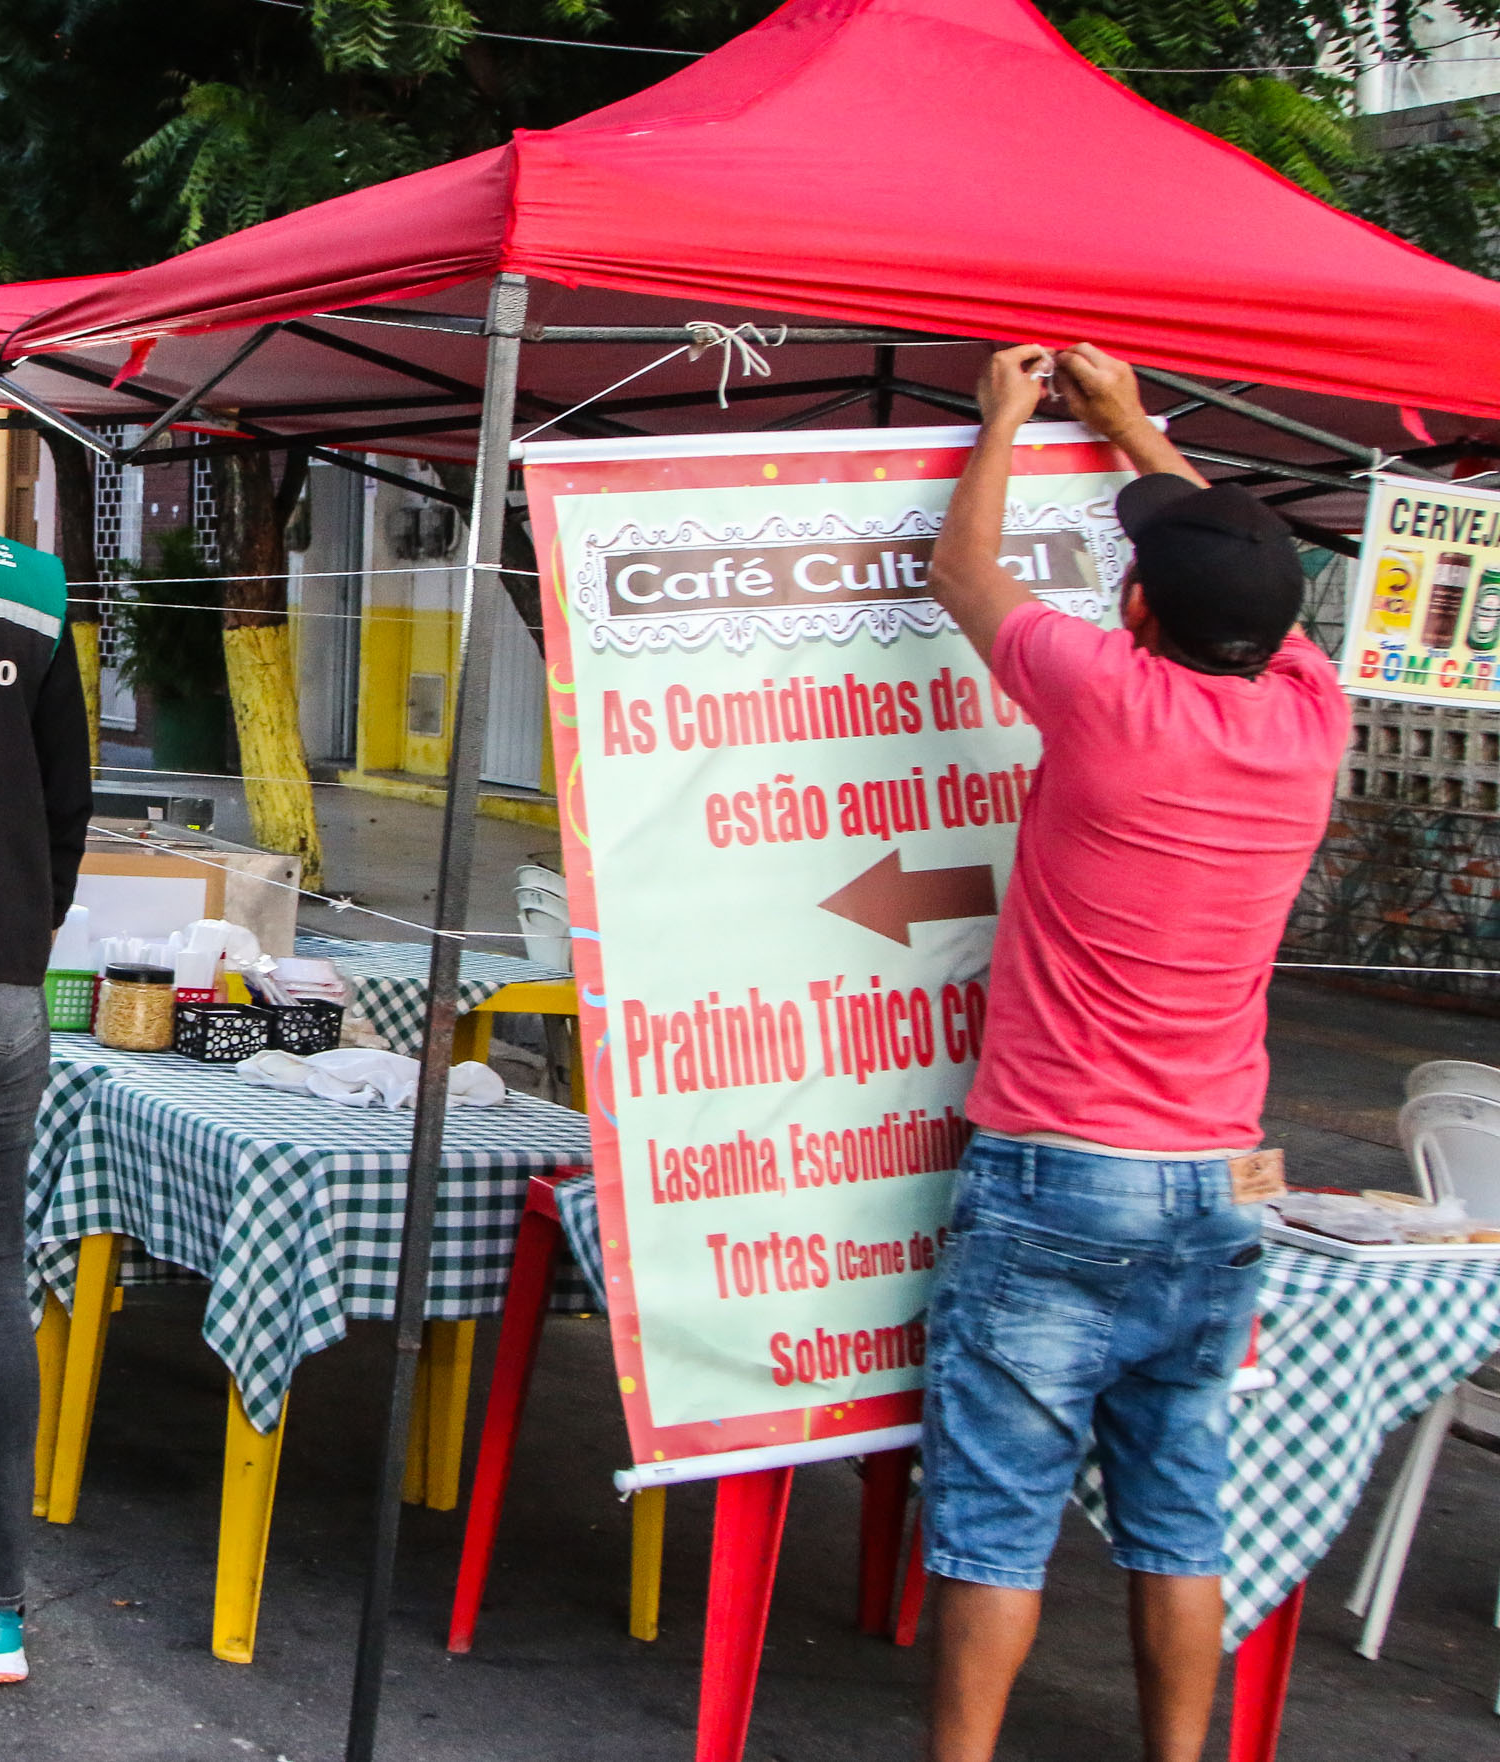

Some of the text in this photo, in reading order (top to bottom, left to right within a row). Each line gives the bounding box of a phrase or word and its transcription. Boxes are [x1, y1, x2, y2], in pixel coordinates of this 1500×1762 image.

[1390, 498, 1500, 547] CERVEJ
[616, 543, 1053, 604] Café Cultal
[1359, 650, 1430, 685] BOM
[603, 689, 658, 757] As
[664, 673, 924, 752] Comidinhas
[929, 667, 984, 732] da
[705, 773, 829, 848] estão
[837, 767, 930, 841] aqui
[623, 987, 806, 1097] Pratinho
[808, 974, 934, 1085] Típico
[647, 1129, 787, 1204] Lasanha,
[706, 1231, 830, 1299] Tortas
[909, 1230, 934, 1271] de
